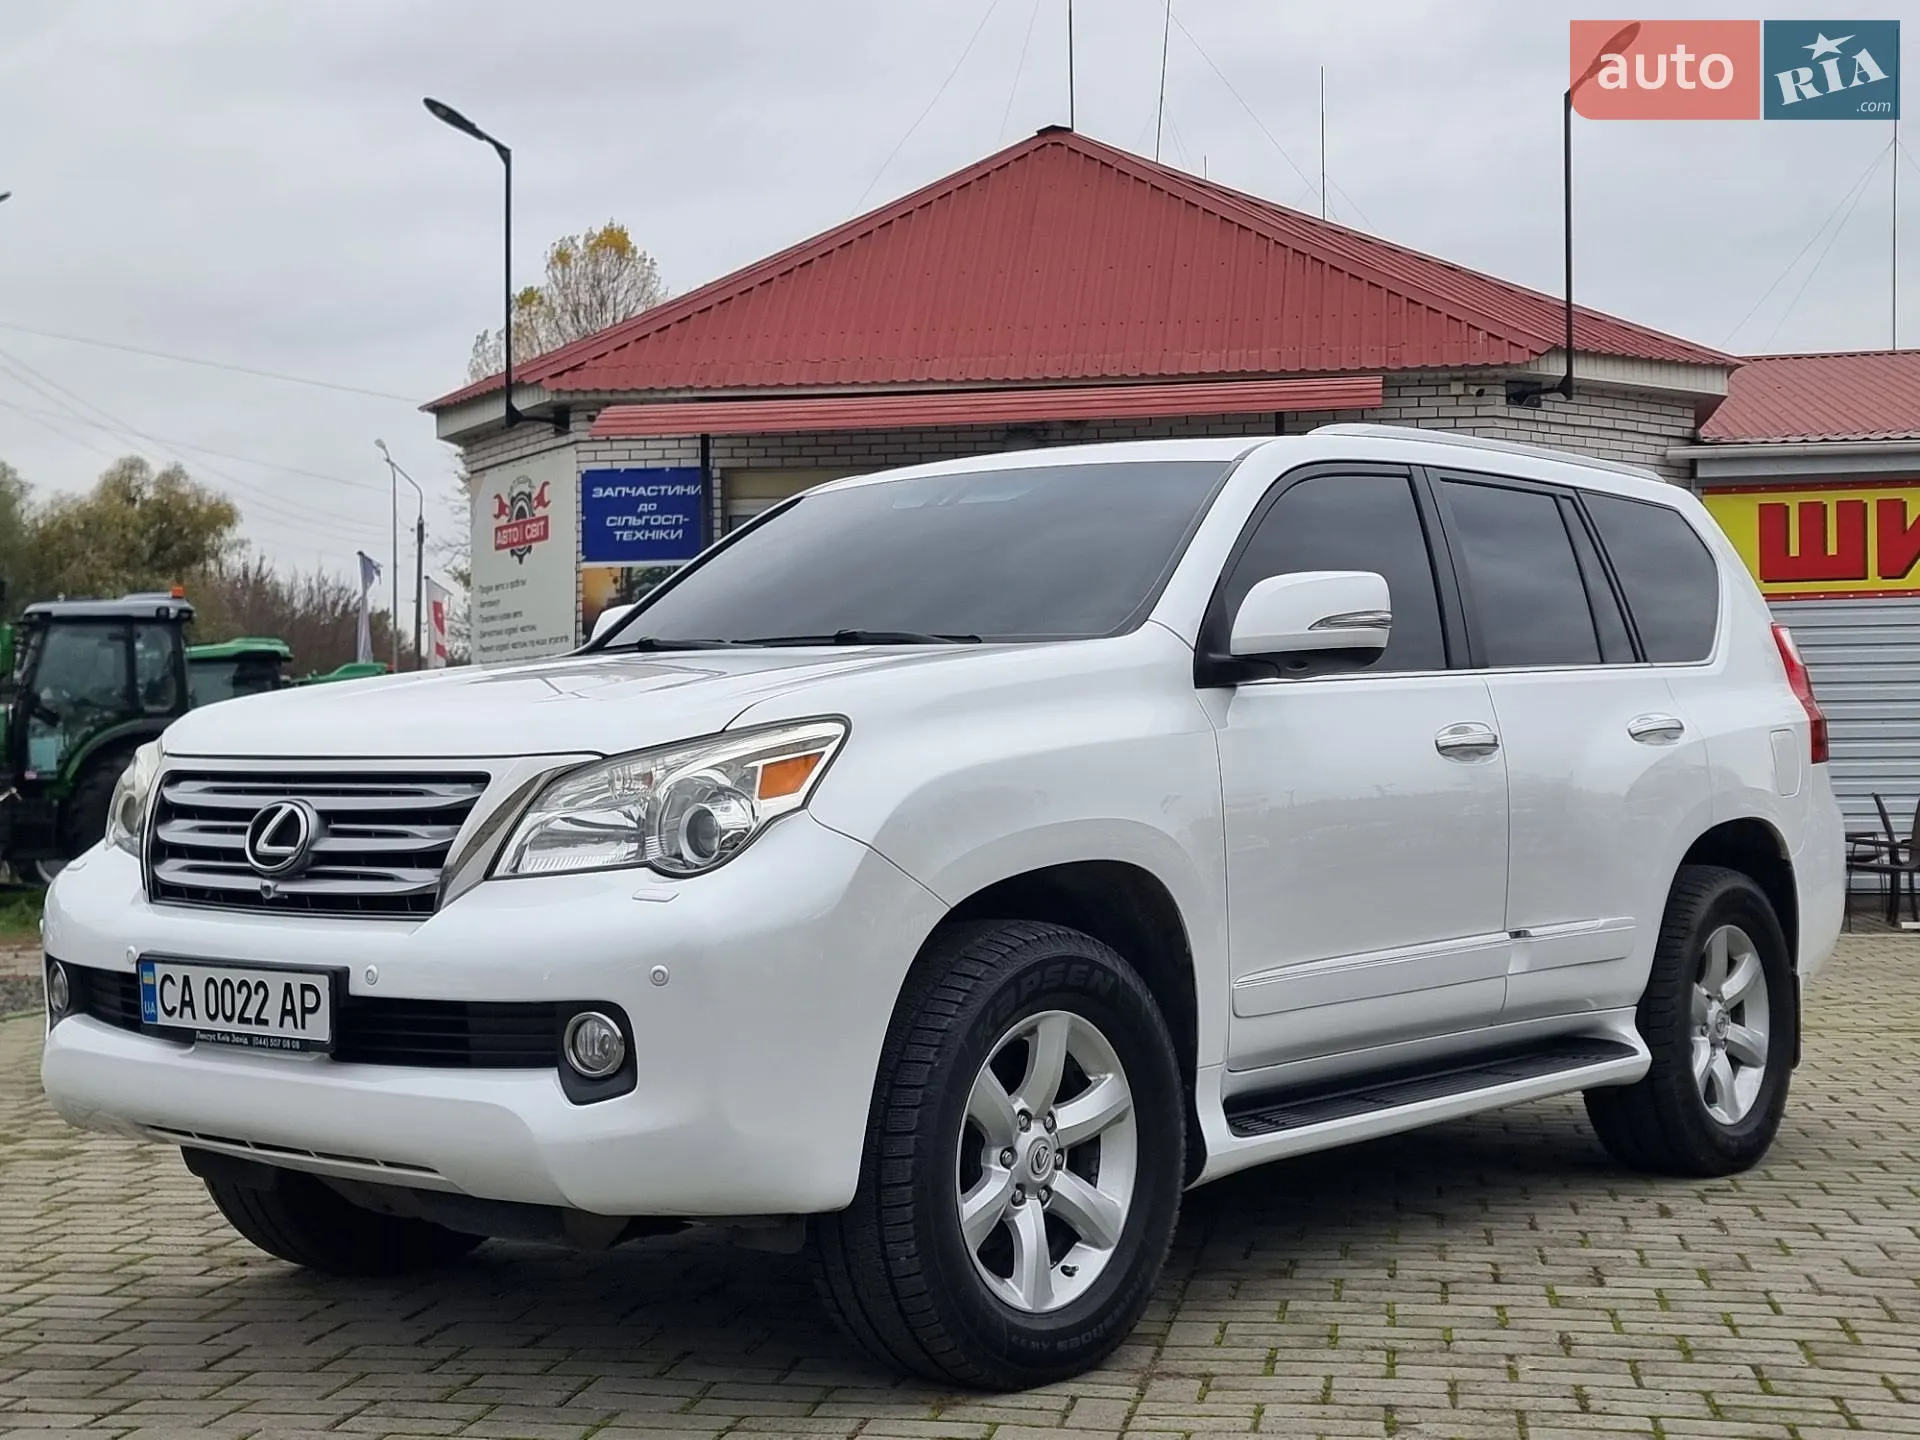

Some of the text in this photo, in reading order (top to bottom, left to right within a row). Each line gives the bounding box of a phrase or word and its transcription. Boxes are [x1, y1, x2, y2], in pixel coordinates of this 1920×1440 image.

[592, 485, 701, 498] ЗАПЧАСТИНИ
[606, 515, 690, 527] СІЛЬГОСП-
[613, 529, 683, 541] ТЕХНІКИ
[144, 1001, 156, 1015] UA
[159, 973, 321, 1030] CA 0022 AP
